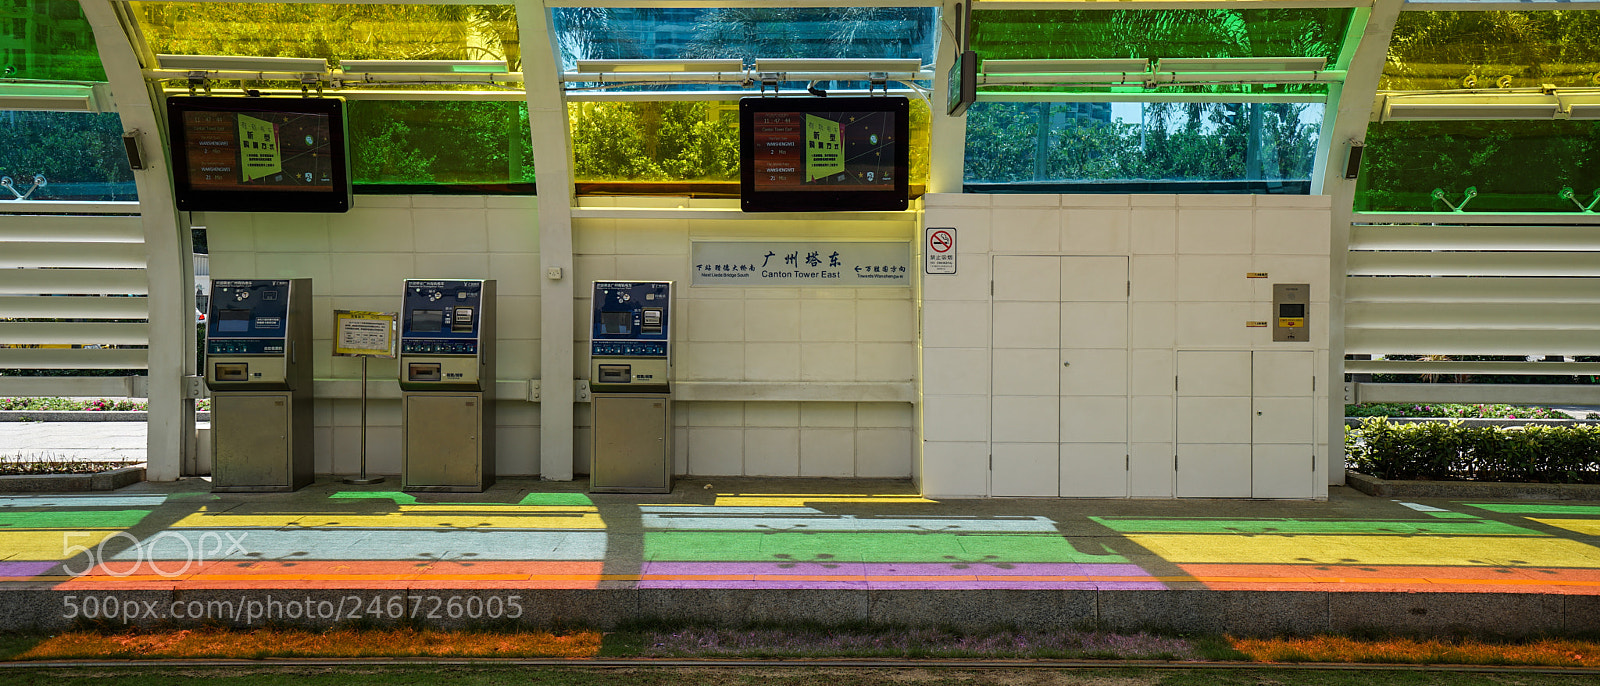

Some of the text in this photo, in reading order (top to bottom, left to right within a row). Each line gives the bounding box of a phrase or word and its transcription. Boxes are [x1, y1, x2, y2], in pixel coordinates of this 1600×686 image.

[761, 250, 841, 269] 广州塔东
[761, 270, 841, 278] Canton Tower East
